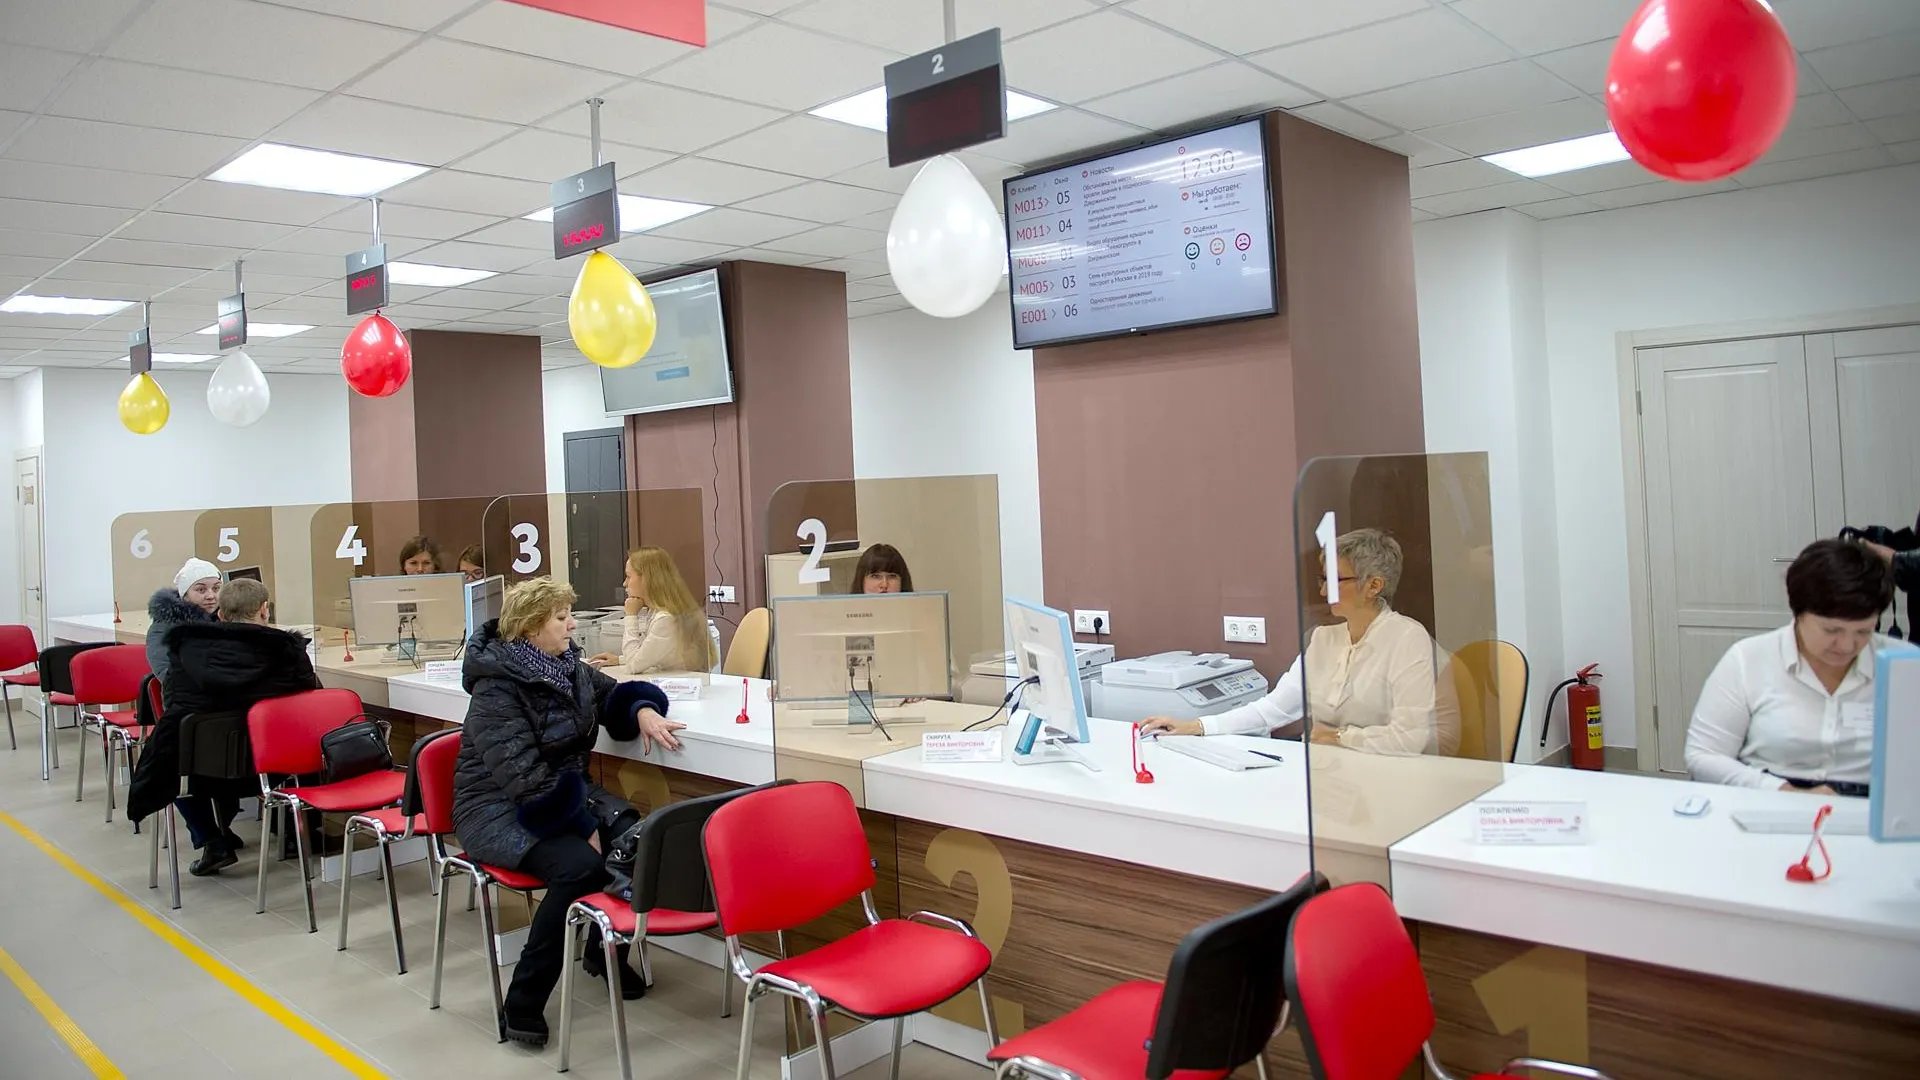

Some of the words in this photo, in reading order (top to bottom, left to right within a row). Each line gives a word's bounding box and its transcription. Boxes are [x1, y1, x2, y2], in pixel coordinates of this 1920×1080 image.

[931, 53, 945, 75] 2
[1089, 166, 1115, 177] Новости
[577, 178, 585, 193] 3
[1192, 190, 1204, 199] Мы
[1205, 182, 1242, 197] работаем:
[1056, 190, 1070, 205] 05
[1058, 218, 1072, 233] 04
[1192, 223, 1218, 234] Оценки
[361, 253, 367, 266] 4
[1060, 248, 1074, 261] 01
[1062, 275, 1076, 289] 03
[1064, 304, 1078, 317] 06
[130, 529, 153, 559] 6
[216, 527, 240, 563] 5
[335, 525, 367, 566] 4
[511, 522, 542, 573] 3
[796, 518, 831, 585] 2
[1315, 511, 1339, 604] 1
